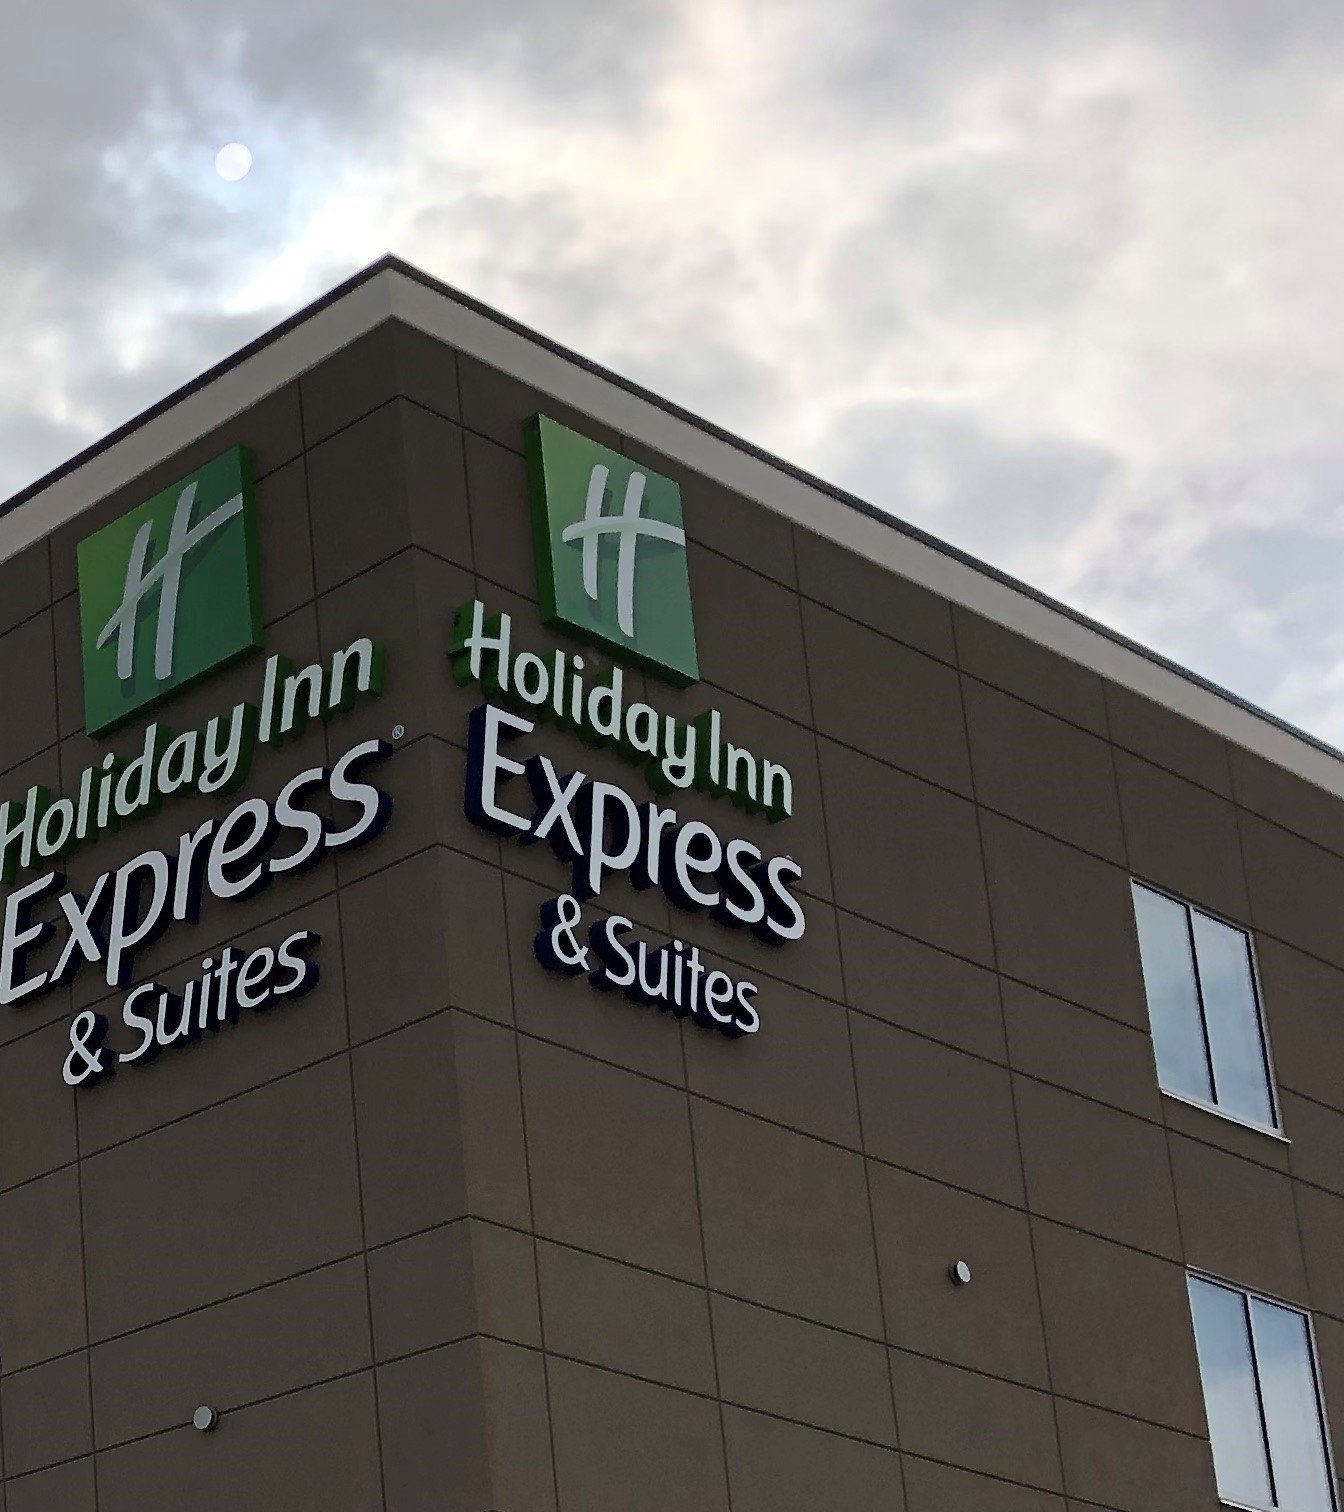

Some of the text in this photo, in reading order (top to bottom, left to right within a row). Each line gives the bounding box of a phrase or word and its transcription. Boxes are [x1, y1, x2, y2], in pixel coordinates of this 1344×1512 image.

[258, 637, 374, 743] Inn
[462, 599, 793, 818] Holiday Inn
[480, 703, 807, 941] Express
[61, 930, 310, 1086] & Suites
[550, 893, 761, 1034] & Suites
